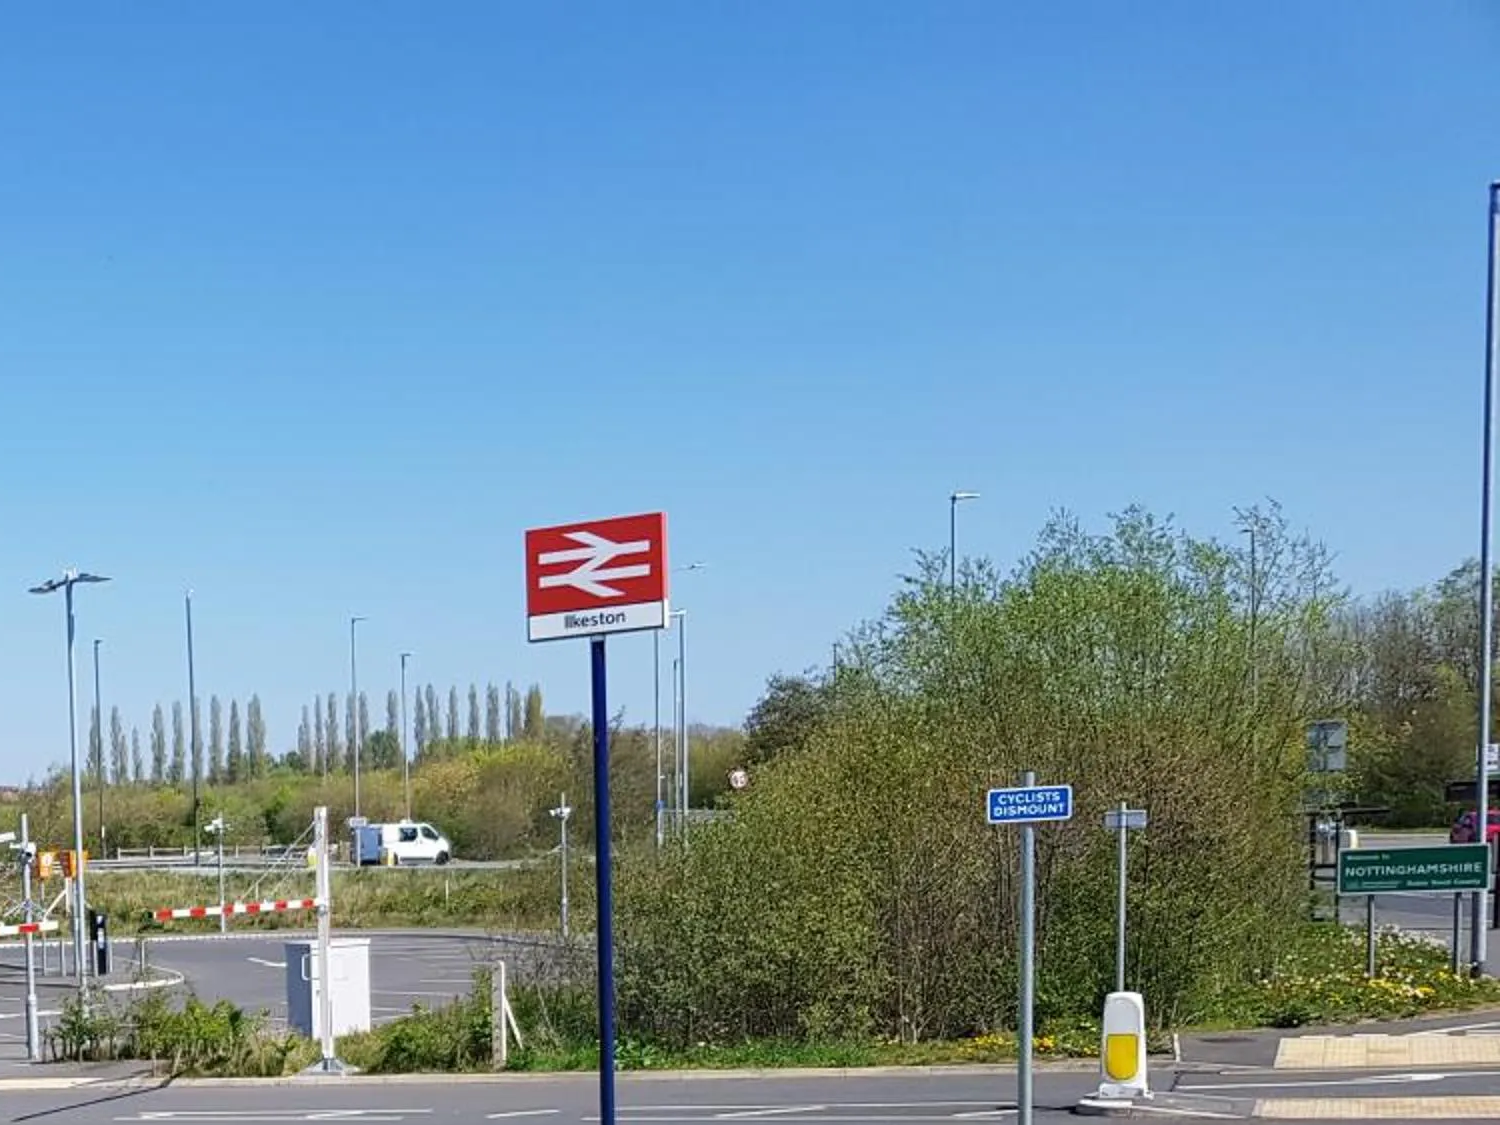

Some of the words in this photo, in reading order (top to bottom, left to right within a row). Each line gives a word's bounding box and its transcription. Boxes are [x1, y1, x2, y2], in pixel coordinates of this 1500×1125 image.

[564, 611, 626, 629] Ilkeston
[997, 791, 1061, 805] CYCLISTS
[993, 802, 1065, 817] DISMOUNT
[1345, 861, 1483, 877] NOTTINGHAMSHIRE
